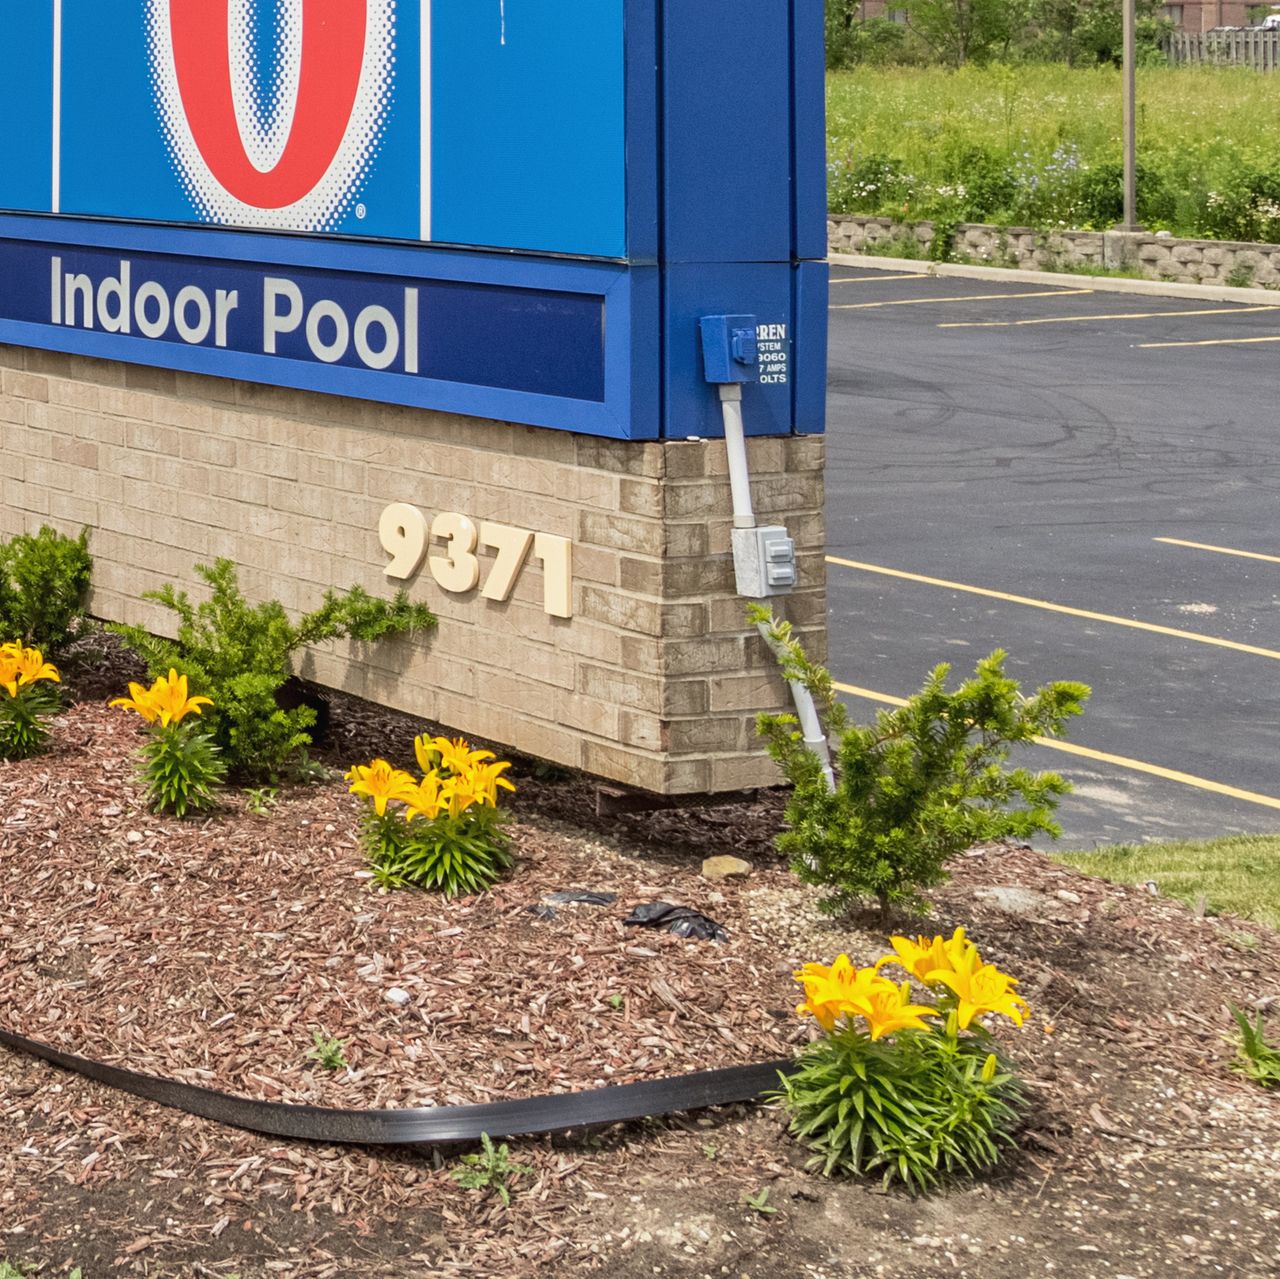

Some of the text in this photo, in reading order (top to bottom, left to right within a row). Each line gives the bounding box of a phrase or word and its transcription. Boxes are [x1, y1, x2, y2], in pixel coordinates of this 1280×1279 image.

[50, 255, 419, 374] Indoor Pool
[766, 363, 787, 373] AMPS
[378, 501, 573, 618] 9371
